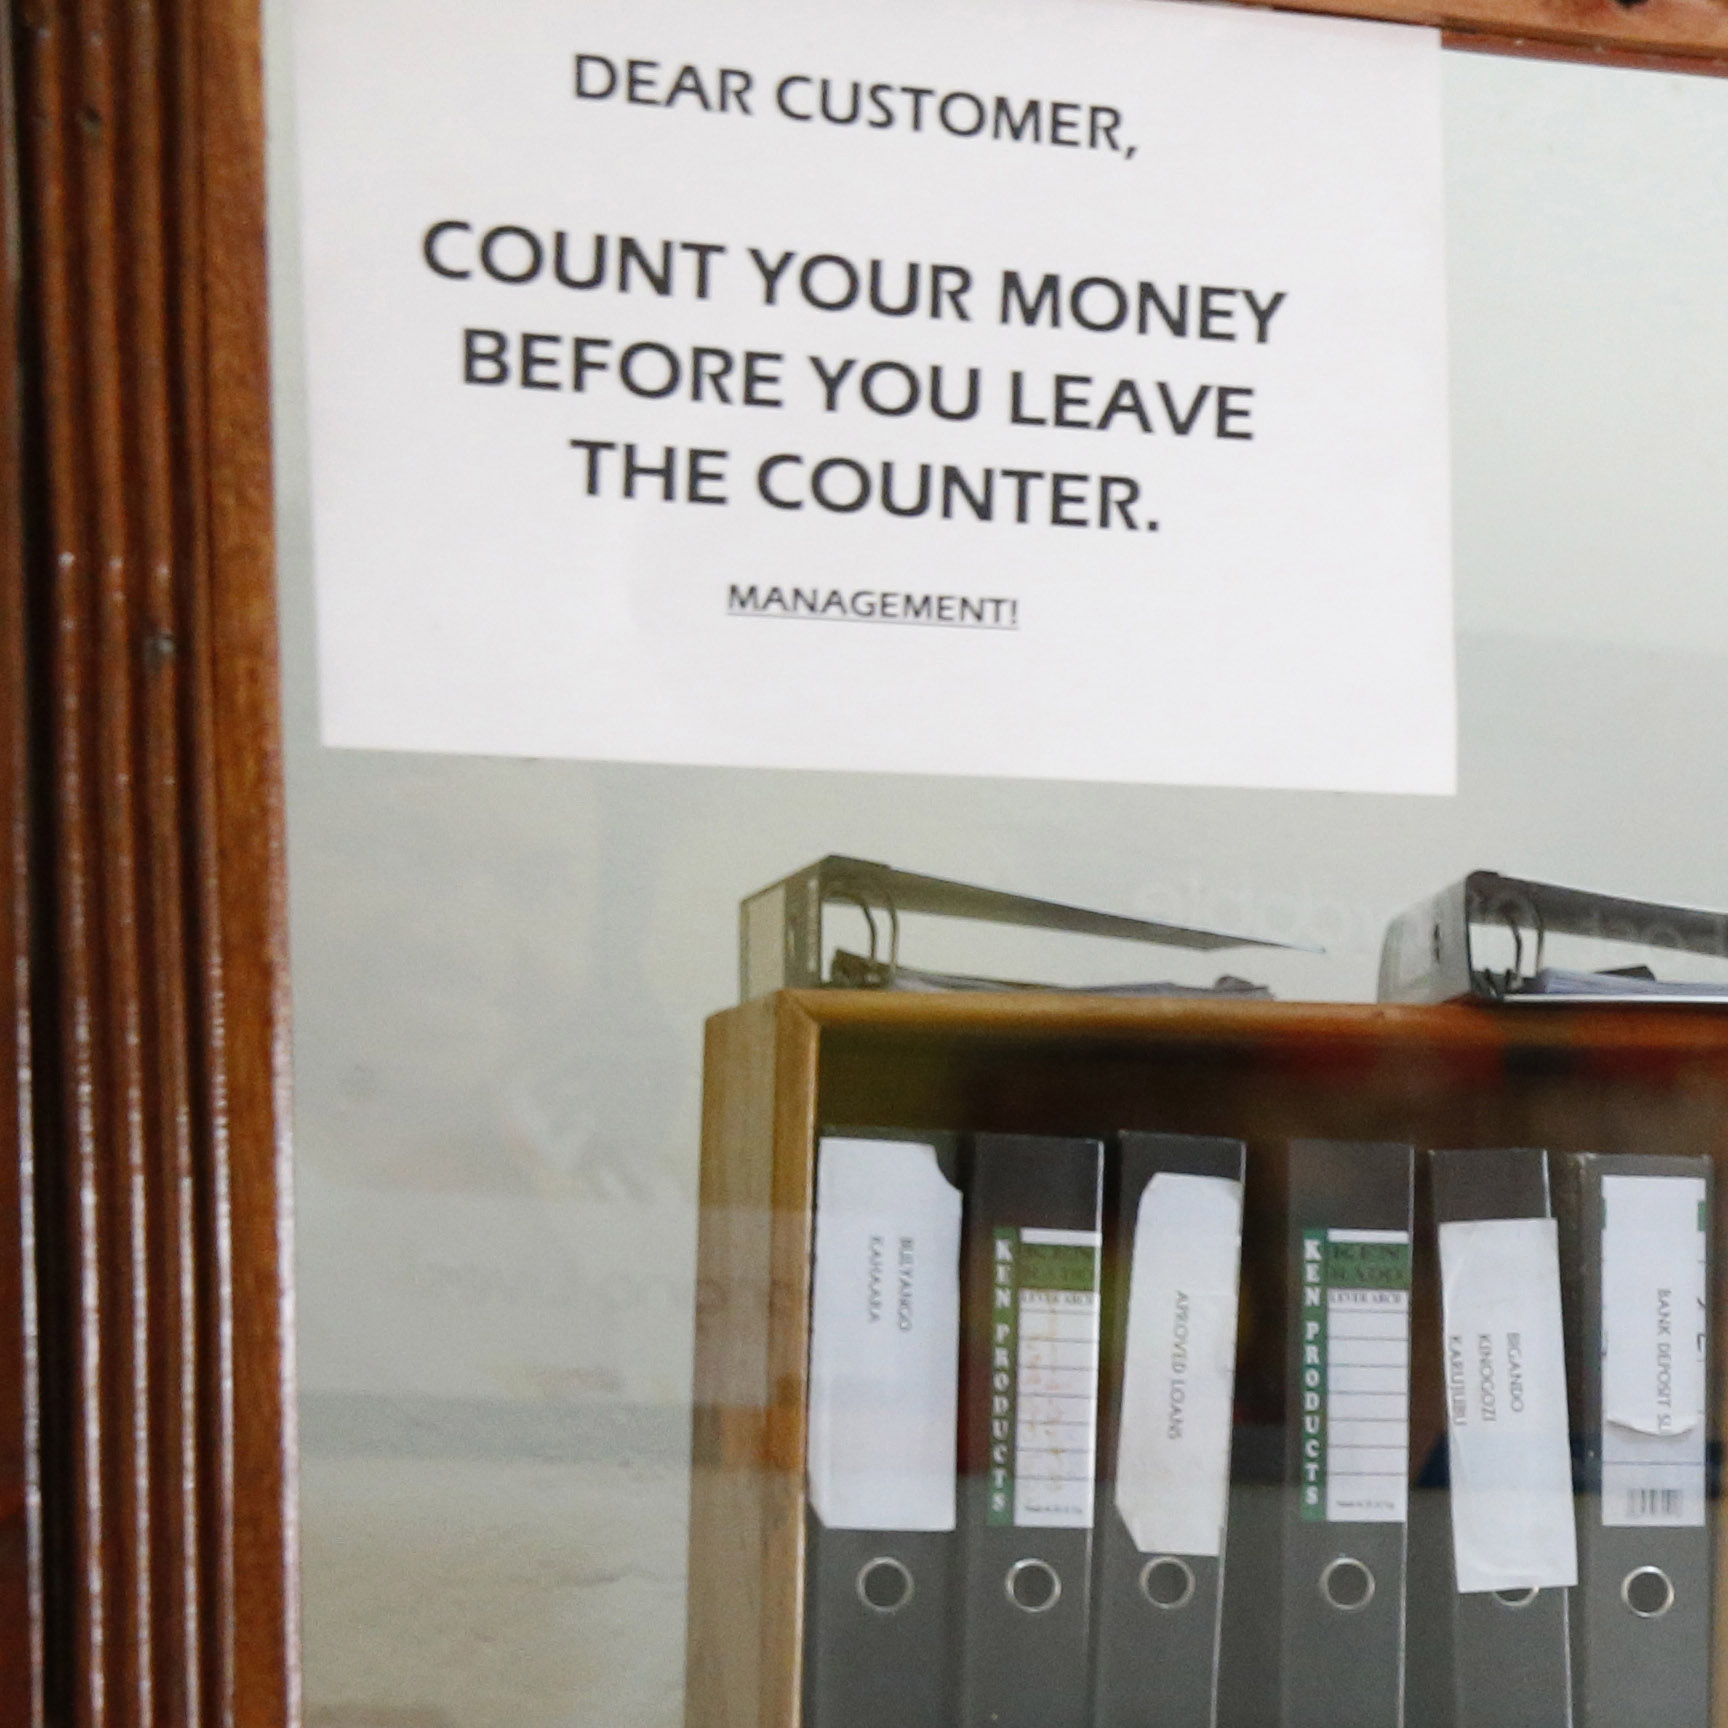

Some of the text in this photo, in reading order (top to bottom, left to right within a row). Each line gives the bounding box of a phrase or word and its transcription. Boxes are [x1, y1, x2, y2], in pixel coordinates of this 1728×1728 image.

[572, 52, 1141, 160] DEAR CUSTOMER,
[422, 219, 1287, 345] COUNT YOUR MONEY
[461, 327, 1255, 441] BEFORE YOU LEAVE
[569, 438, 1160, 533] THE COUNTER.
[726, 583, 1020, 630] MANAGEMENT!
[1304, 1239, 1321, 1307] KEN
[1657, 1288, 1672, 1335] BANK
[1167, 1379, 1186, 1440] LOANS
[1304, 1322, 1321, 1506] PRODUCTS
[1657, 1342, 1672, 1408] DEPOSIT
